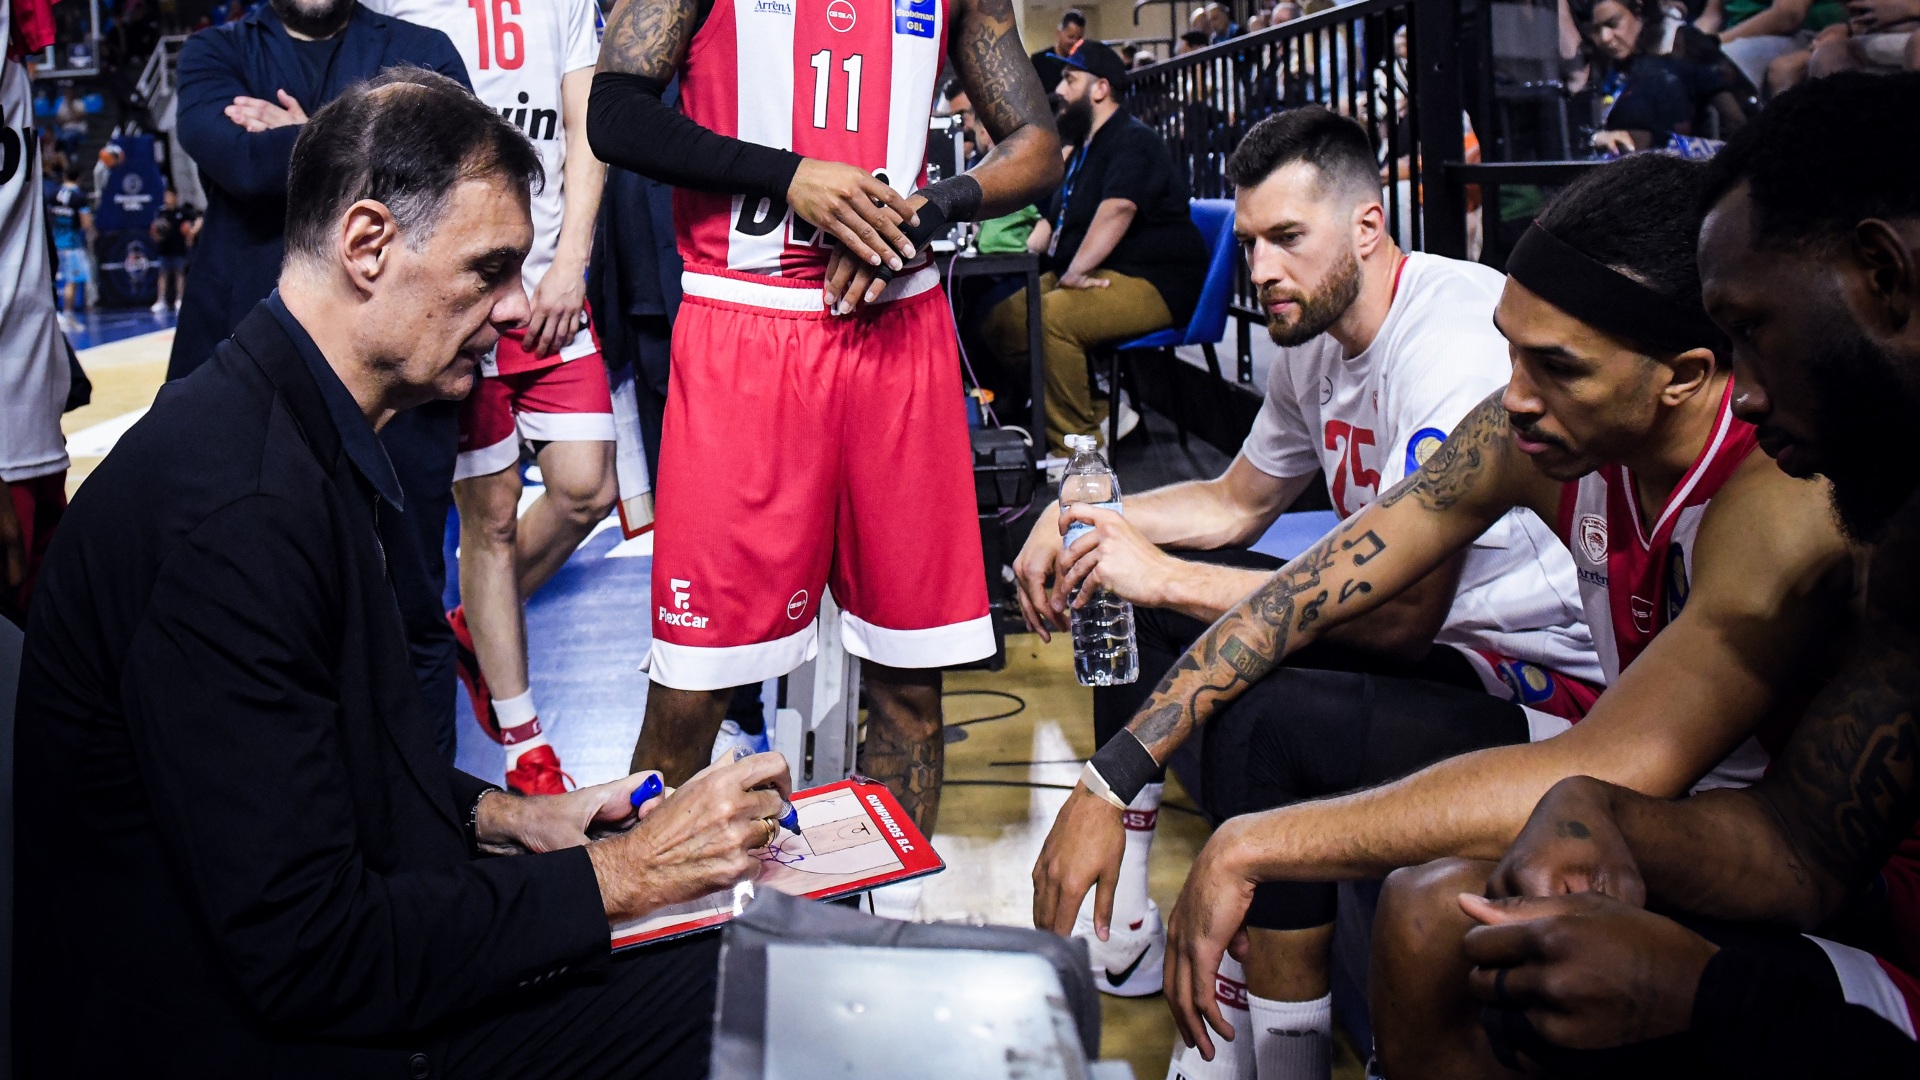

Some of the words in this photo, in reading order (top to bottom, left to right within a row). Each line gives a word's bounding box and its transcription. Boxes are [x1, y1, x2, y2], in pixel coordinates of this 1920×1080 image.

[468, 0, 525, 70] 16
[829, 10, 854, 20] GSA
[906, 21, 925, 32] GBL
[810, 49, 863, 133] 11
[1325, 420, 1381, 520] 25
[658, 606, 709, 629] FlexCar
[865, 794, 905, 838] OLYMPIACOS
